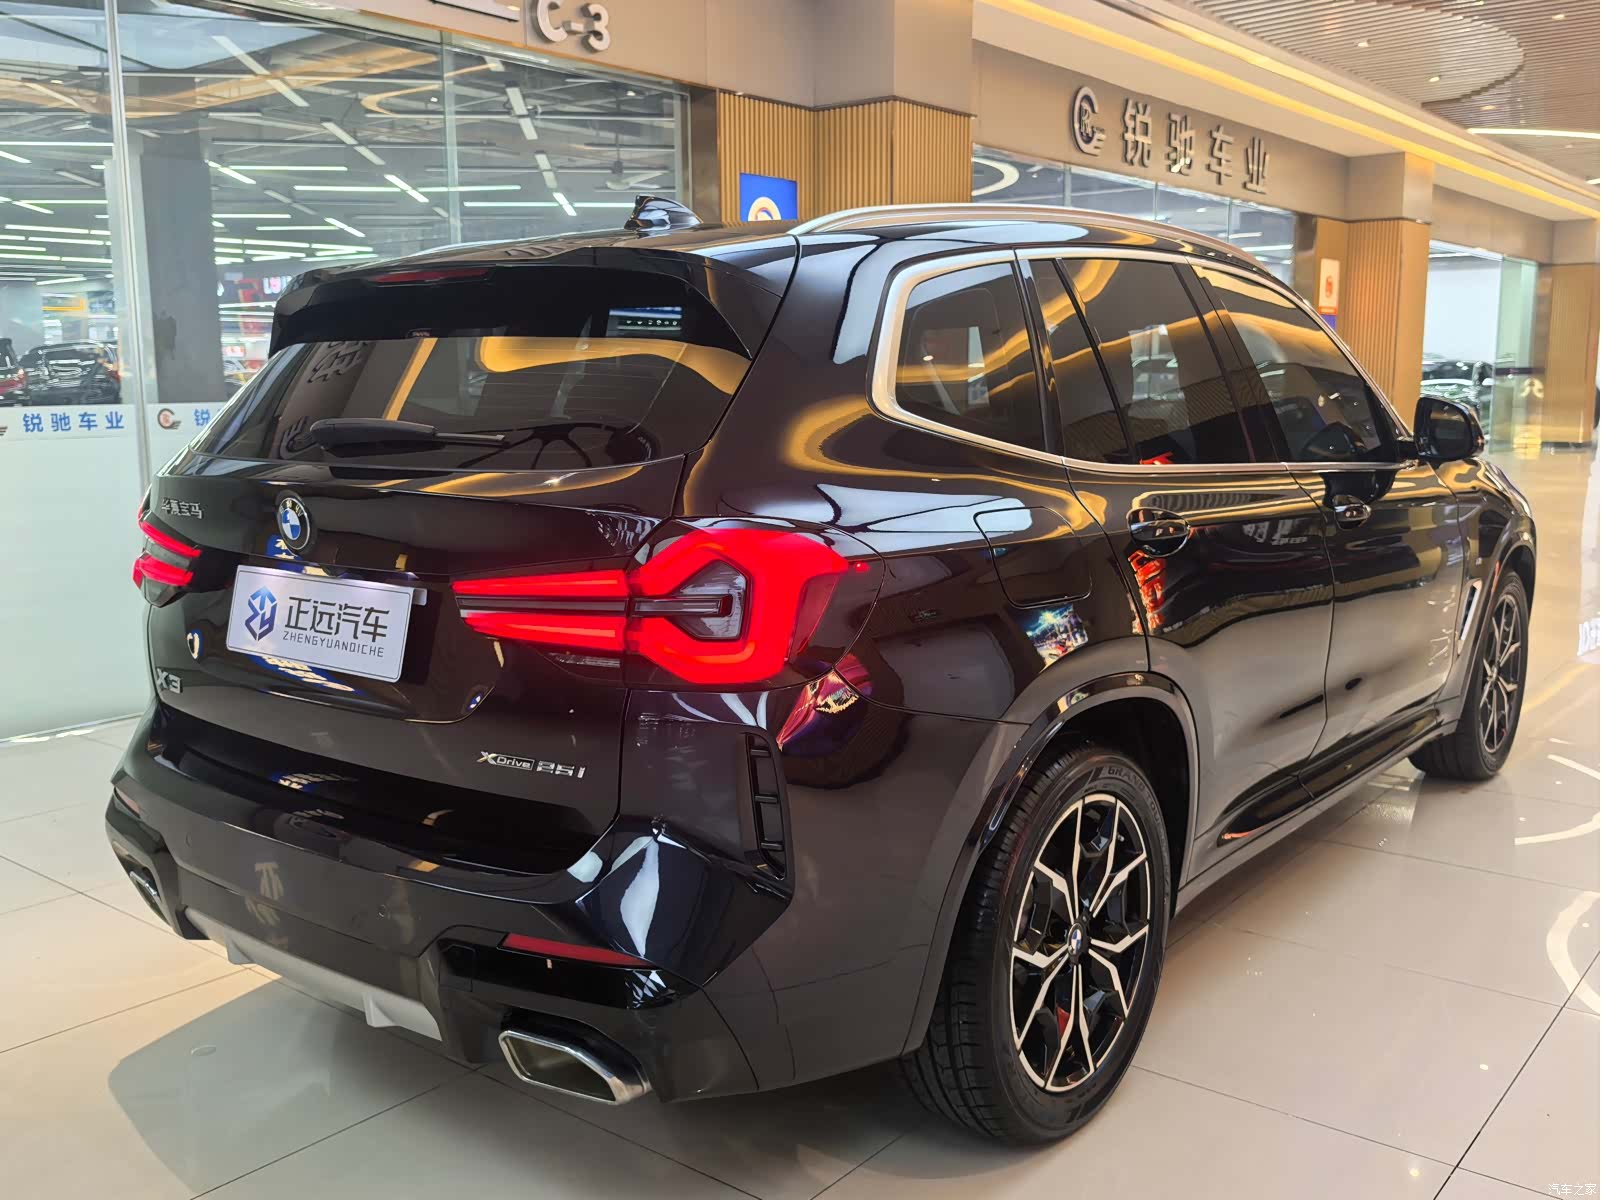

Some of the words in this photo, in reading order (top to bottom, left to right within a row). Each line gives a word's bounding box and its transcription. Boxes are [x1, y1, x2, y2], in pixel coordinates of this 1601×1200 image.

[530, 0, 611, 52] C-3
[1121, 98, 1270, 195] 锐驰车业
[22, 411, 126, 433] 锐驰车业
[285, 596, 390, 643] 正远汽车
[282, 630, 385, 658] ZHENGYUANQICHE
[156, 667, 182, 694] X3
